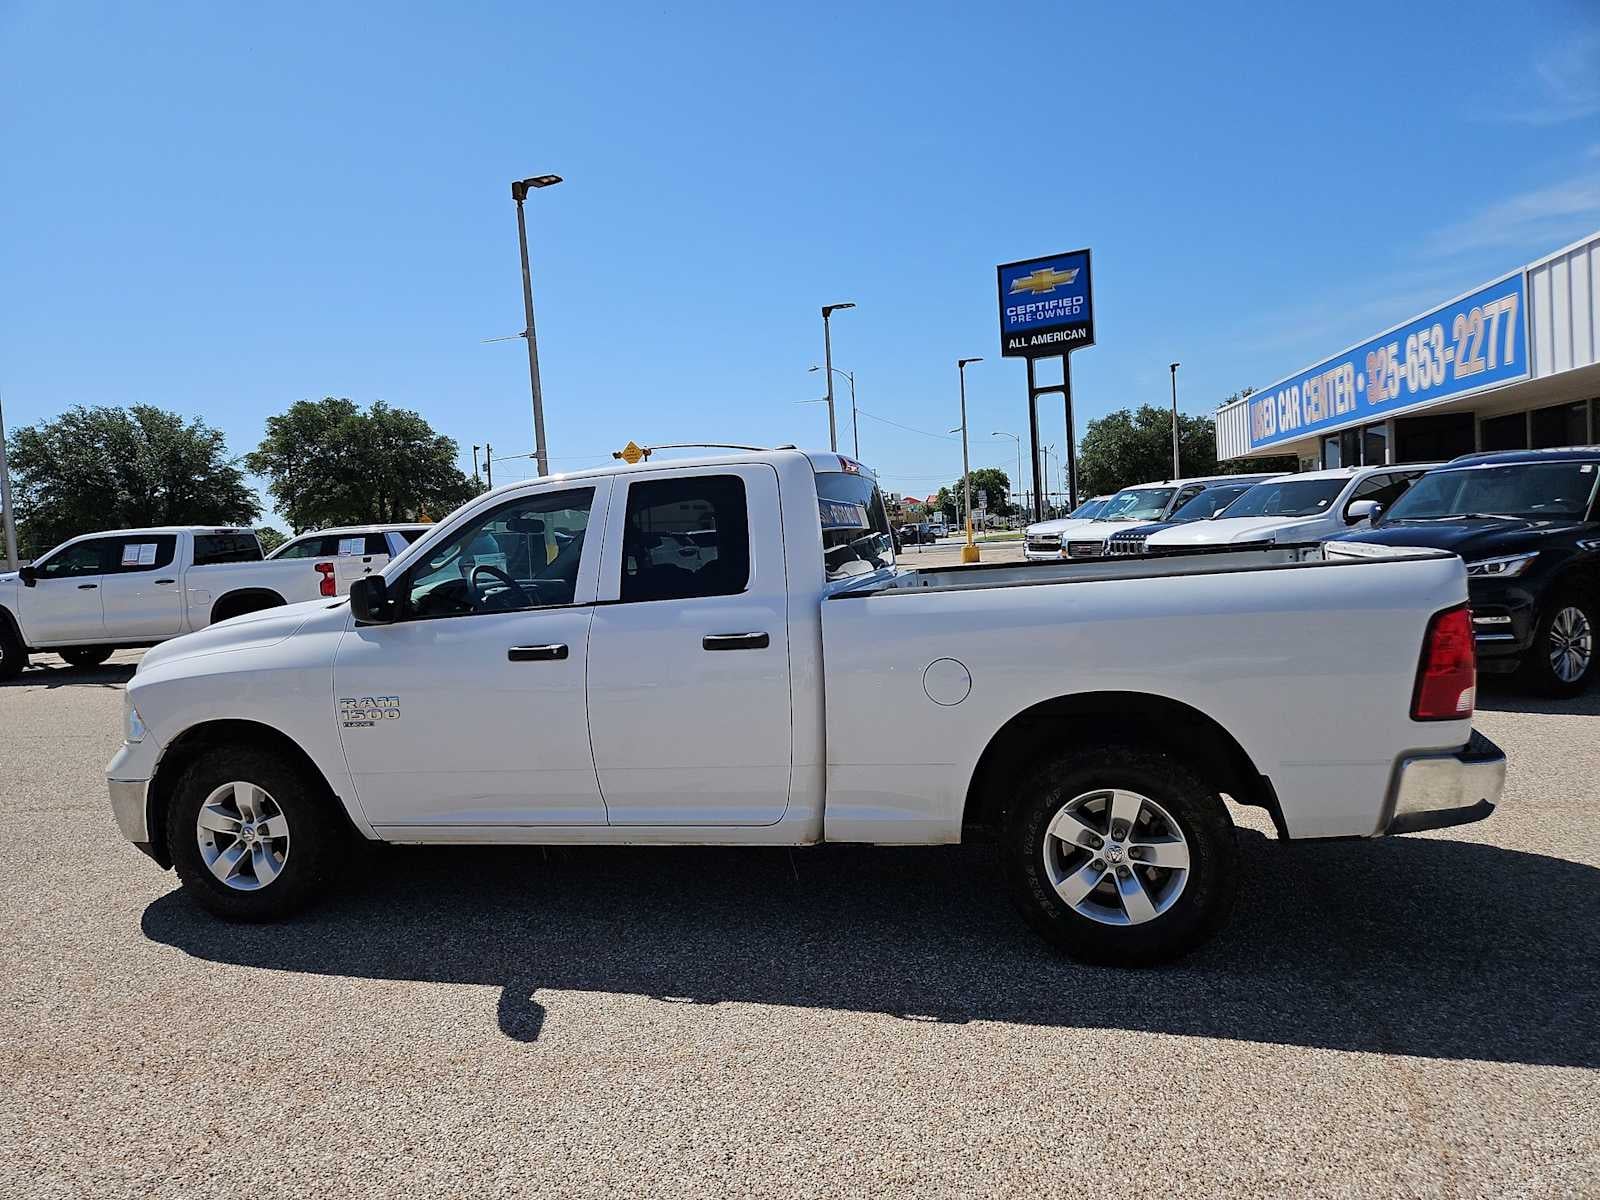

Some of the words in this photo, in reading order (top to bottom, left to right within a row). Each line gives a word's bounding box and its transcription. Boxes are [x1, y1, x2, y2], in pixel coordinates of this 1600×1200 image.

[1006, 295, 1084, 316] CERTIFIED
[1010, 305, 1081, 324] PRE-OWNED
[1008, 337, 1028, 350] ALL
[1030, 328, 1087, 346] AMERICAN
[1277, 385, 1301, 433] CAR
[1302, 361, 1357, 426] CENTER
[339, 695, 401, 709] RAM
[340, 707, 401, 721] 1500
